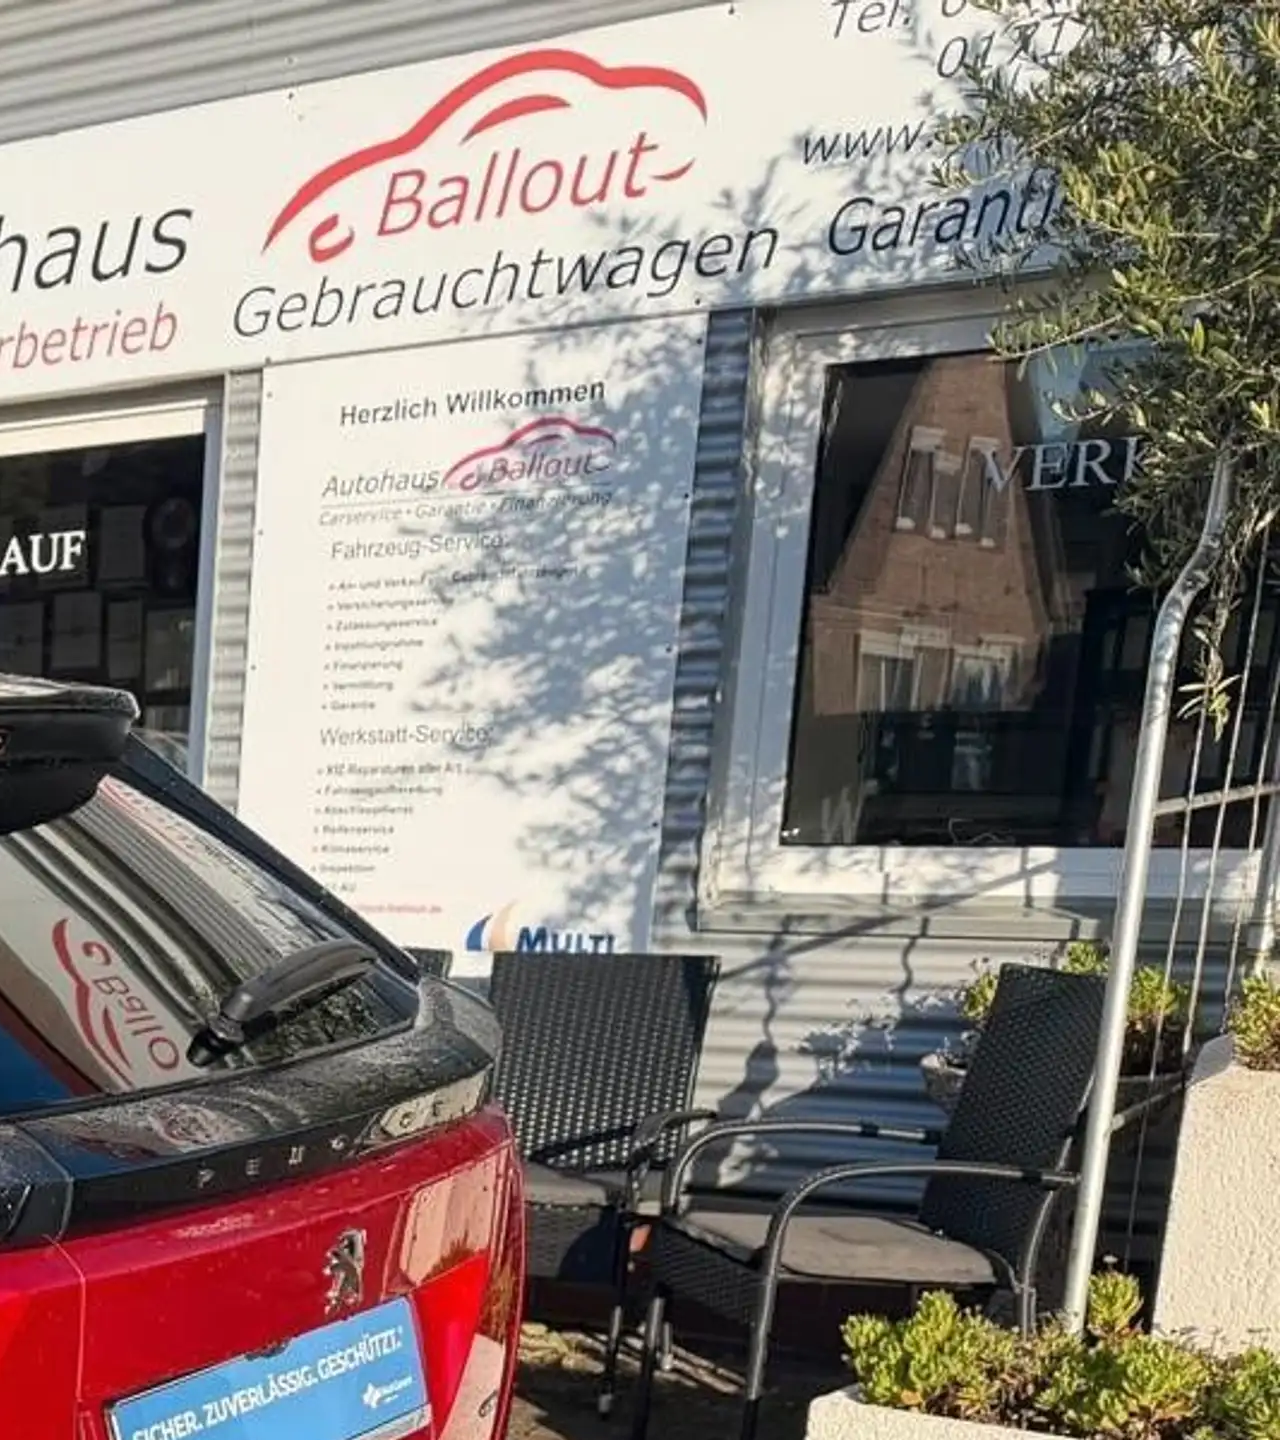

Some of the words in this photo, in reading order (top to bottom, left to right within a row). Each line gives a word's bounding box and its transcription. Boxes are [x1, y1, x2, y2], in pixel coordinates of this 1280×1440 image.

[804, 121, 933, 165] www.
[377, 132, 658, 236] Ballout
[828, 164, 1060, 256] Garanti
[234, 226, 778, 337] Gebrauchtwagen
[340, 398, 437, 427] Herzlich
[446, 380, 606, 416] Willkommen
[322, 469, 439, 498] Autohaus
[491, 451, 604, 485] Ballout
[980, 434, 1148, 494] VERK
[203, 1368, 319, 1426] ZUVERLÄSSIG.
